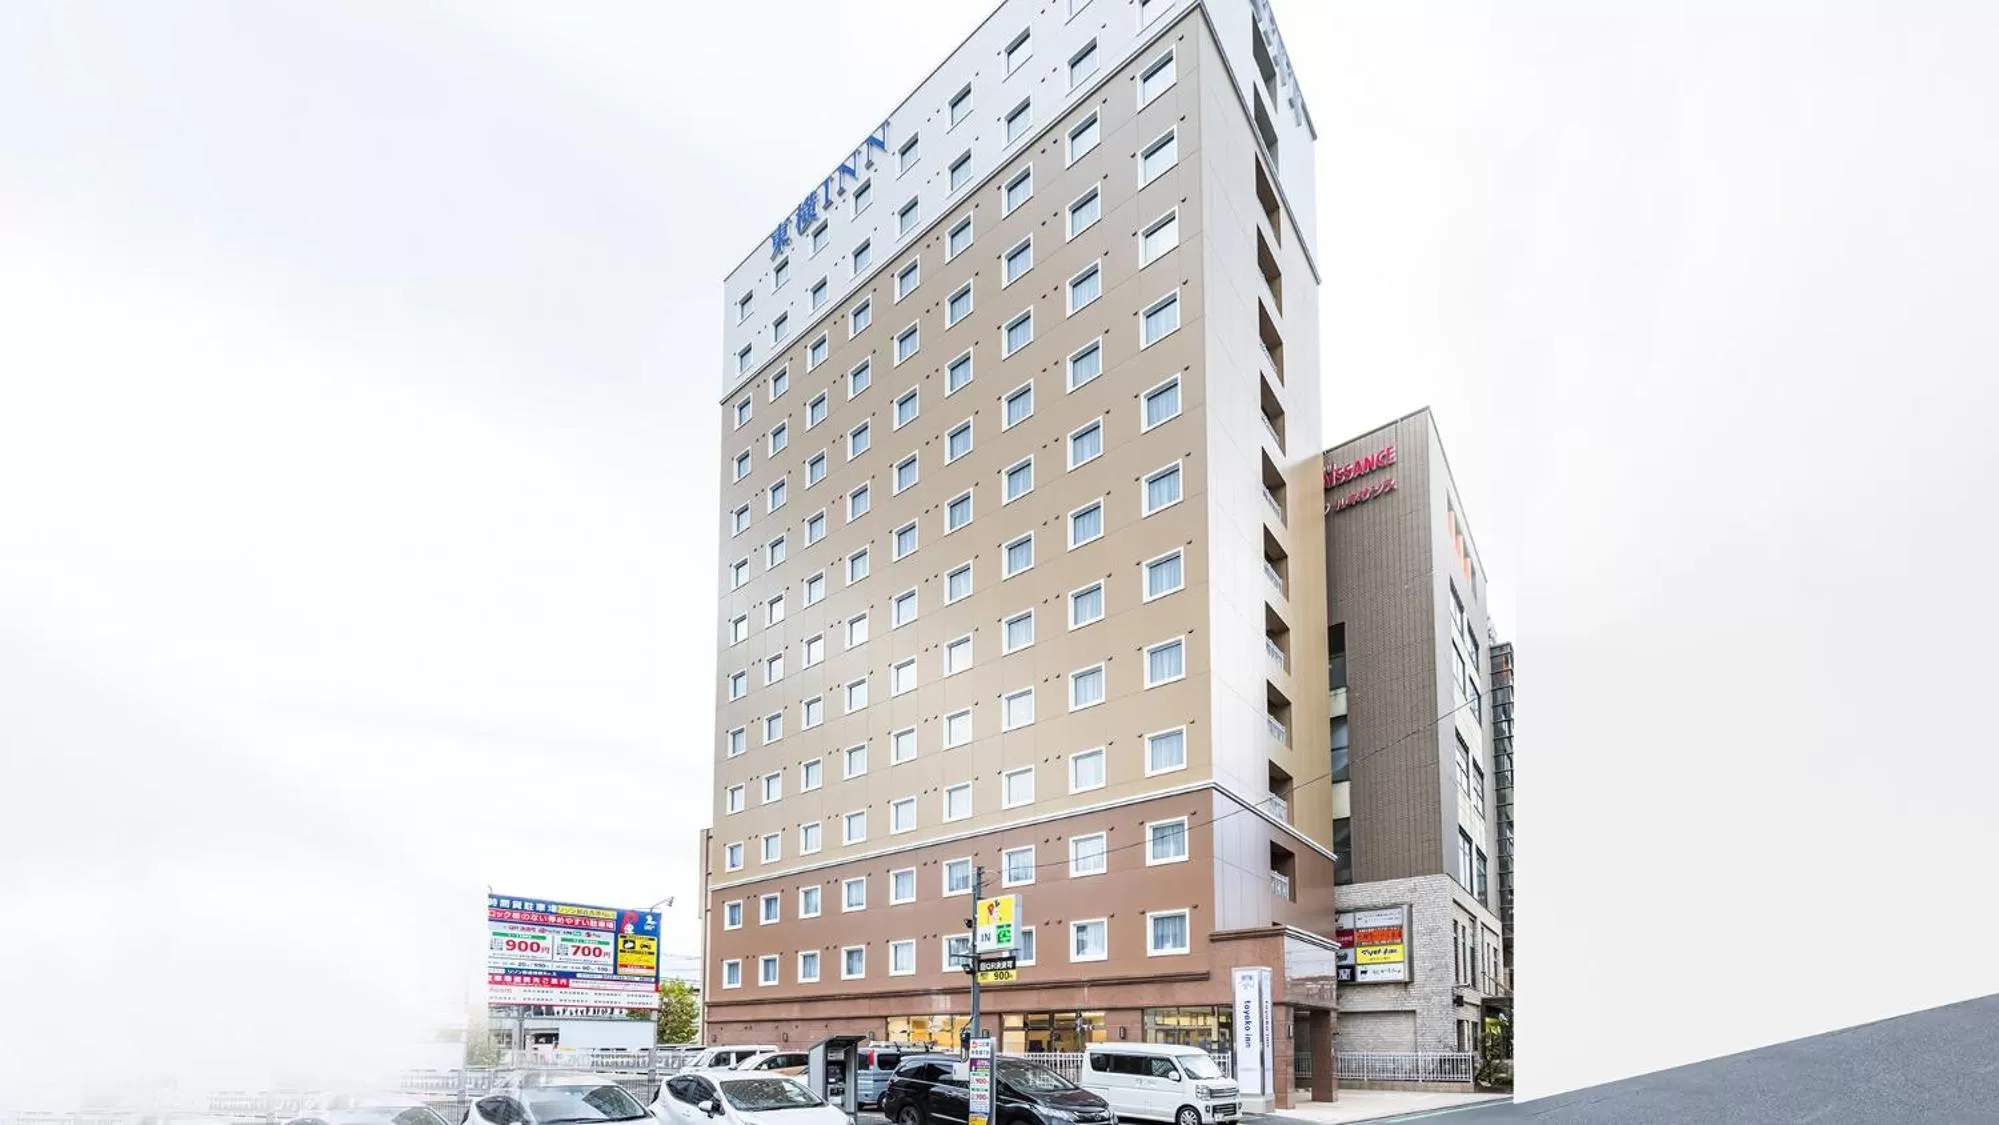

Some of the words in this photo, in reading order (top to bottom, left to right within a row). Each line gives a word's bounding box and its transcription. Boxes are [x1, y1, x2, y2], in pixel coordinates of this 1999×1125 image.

[980, 932, 991, 943] IN
[1243, 1000, 1252, 1031] toyoko
[1244, 1033, 1253, 1049] inn
